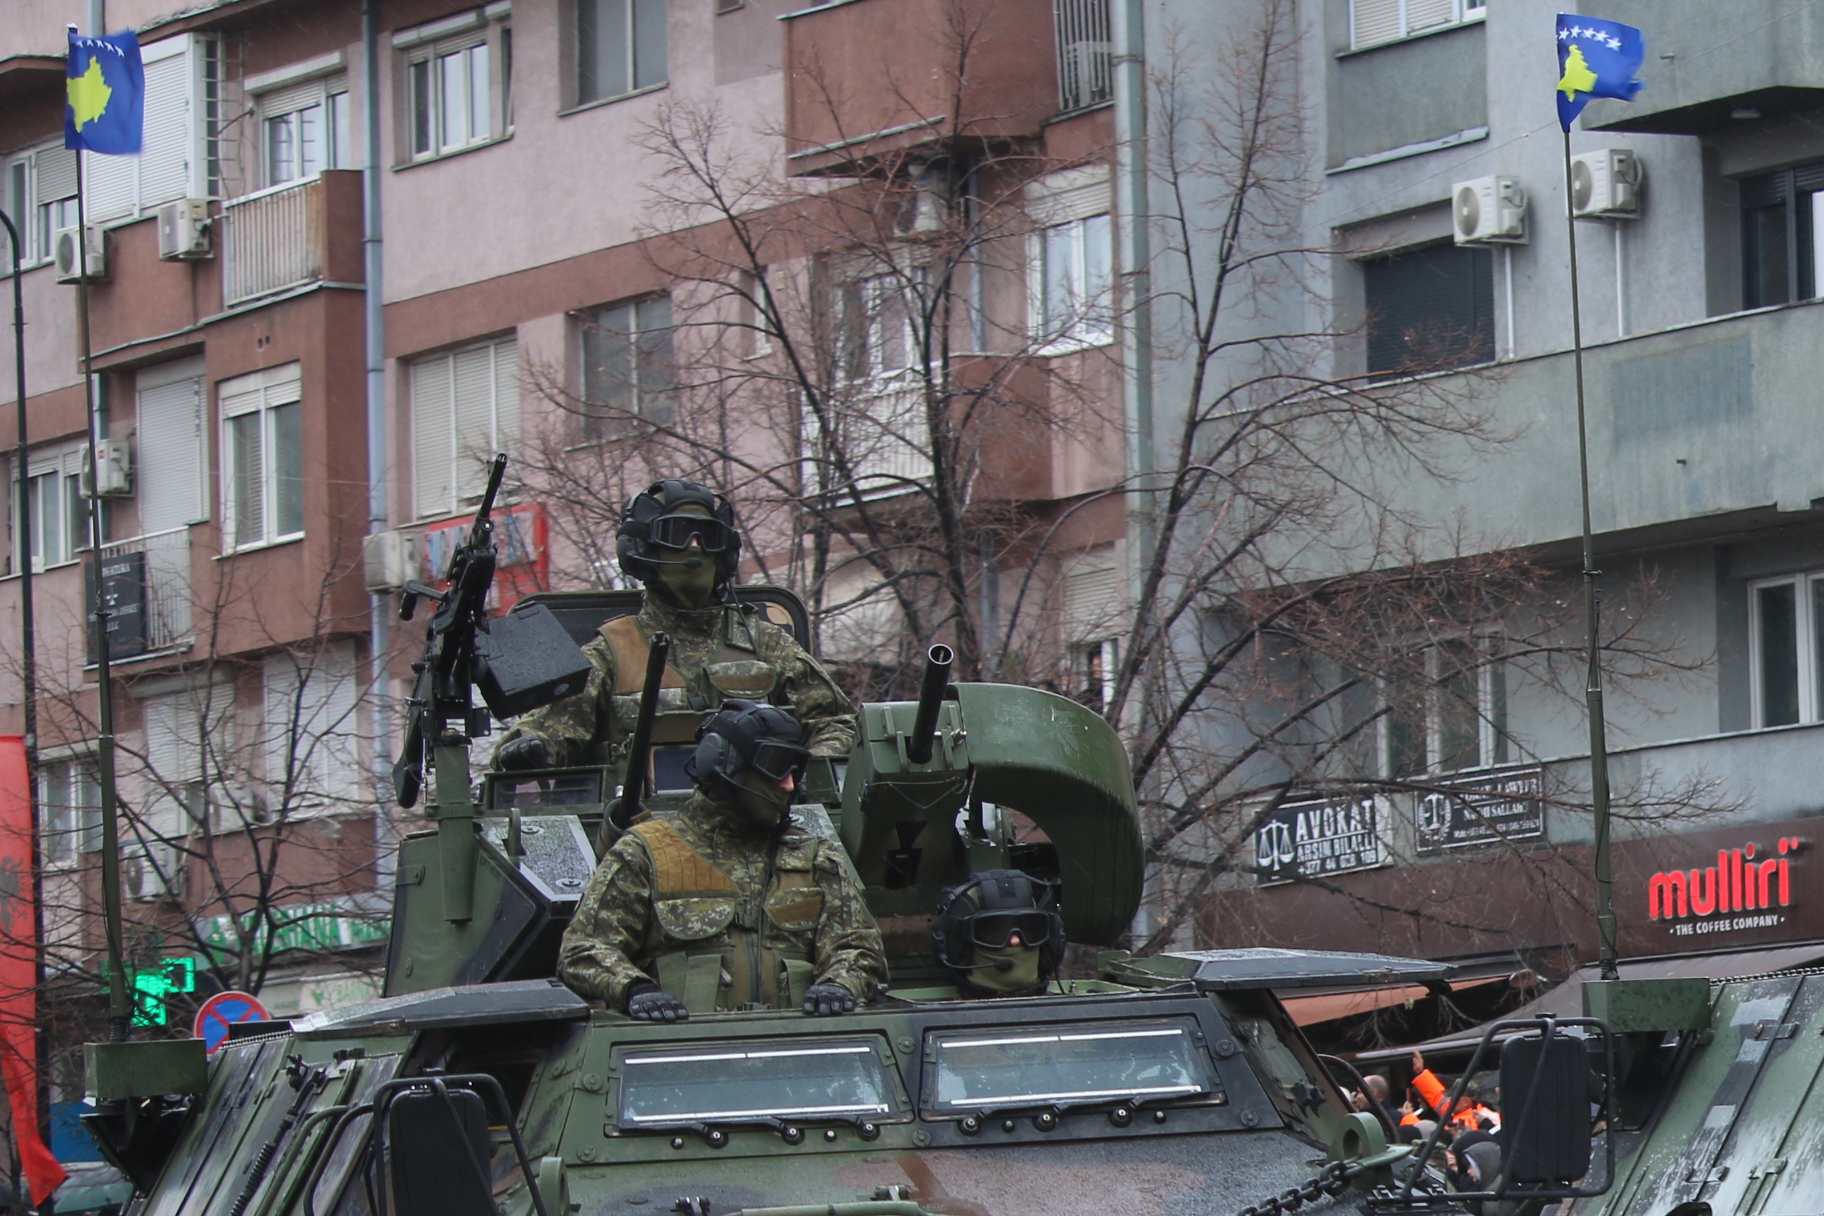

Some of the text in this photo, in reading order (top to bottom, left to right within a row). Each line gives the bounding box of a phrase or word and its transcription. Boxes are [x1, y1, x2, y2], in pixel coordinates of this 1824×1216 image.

[1296, 799, 1373, 842] AVOKAT
[1649, 836, 1799, 921] mulliri
[1675, 914, 1779, 936] THE COFFEE COMPANY
